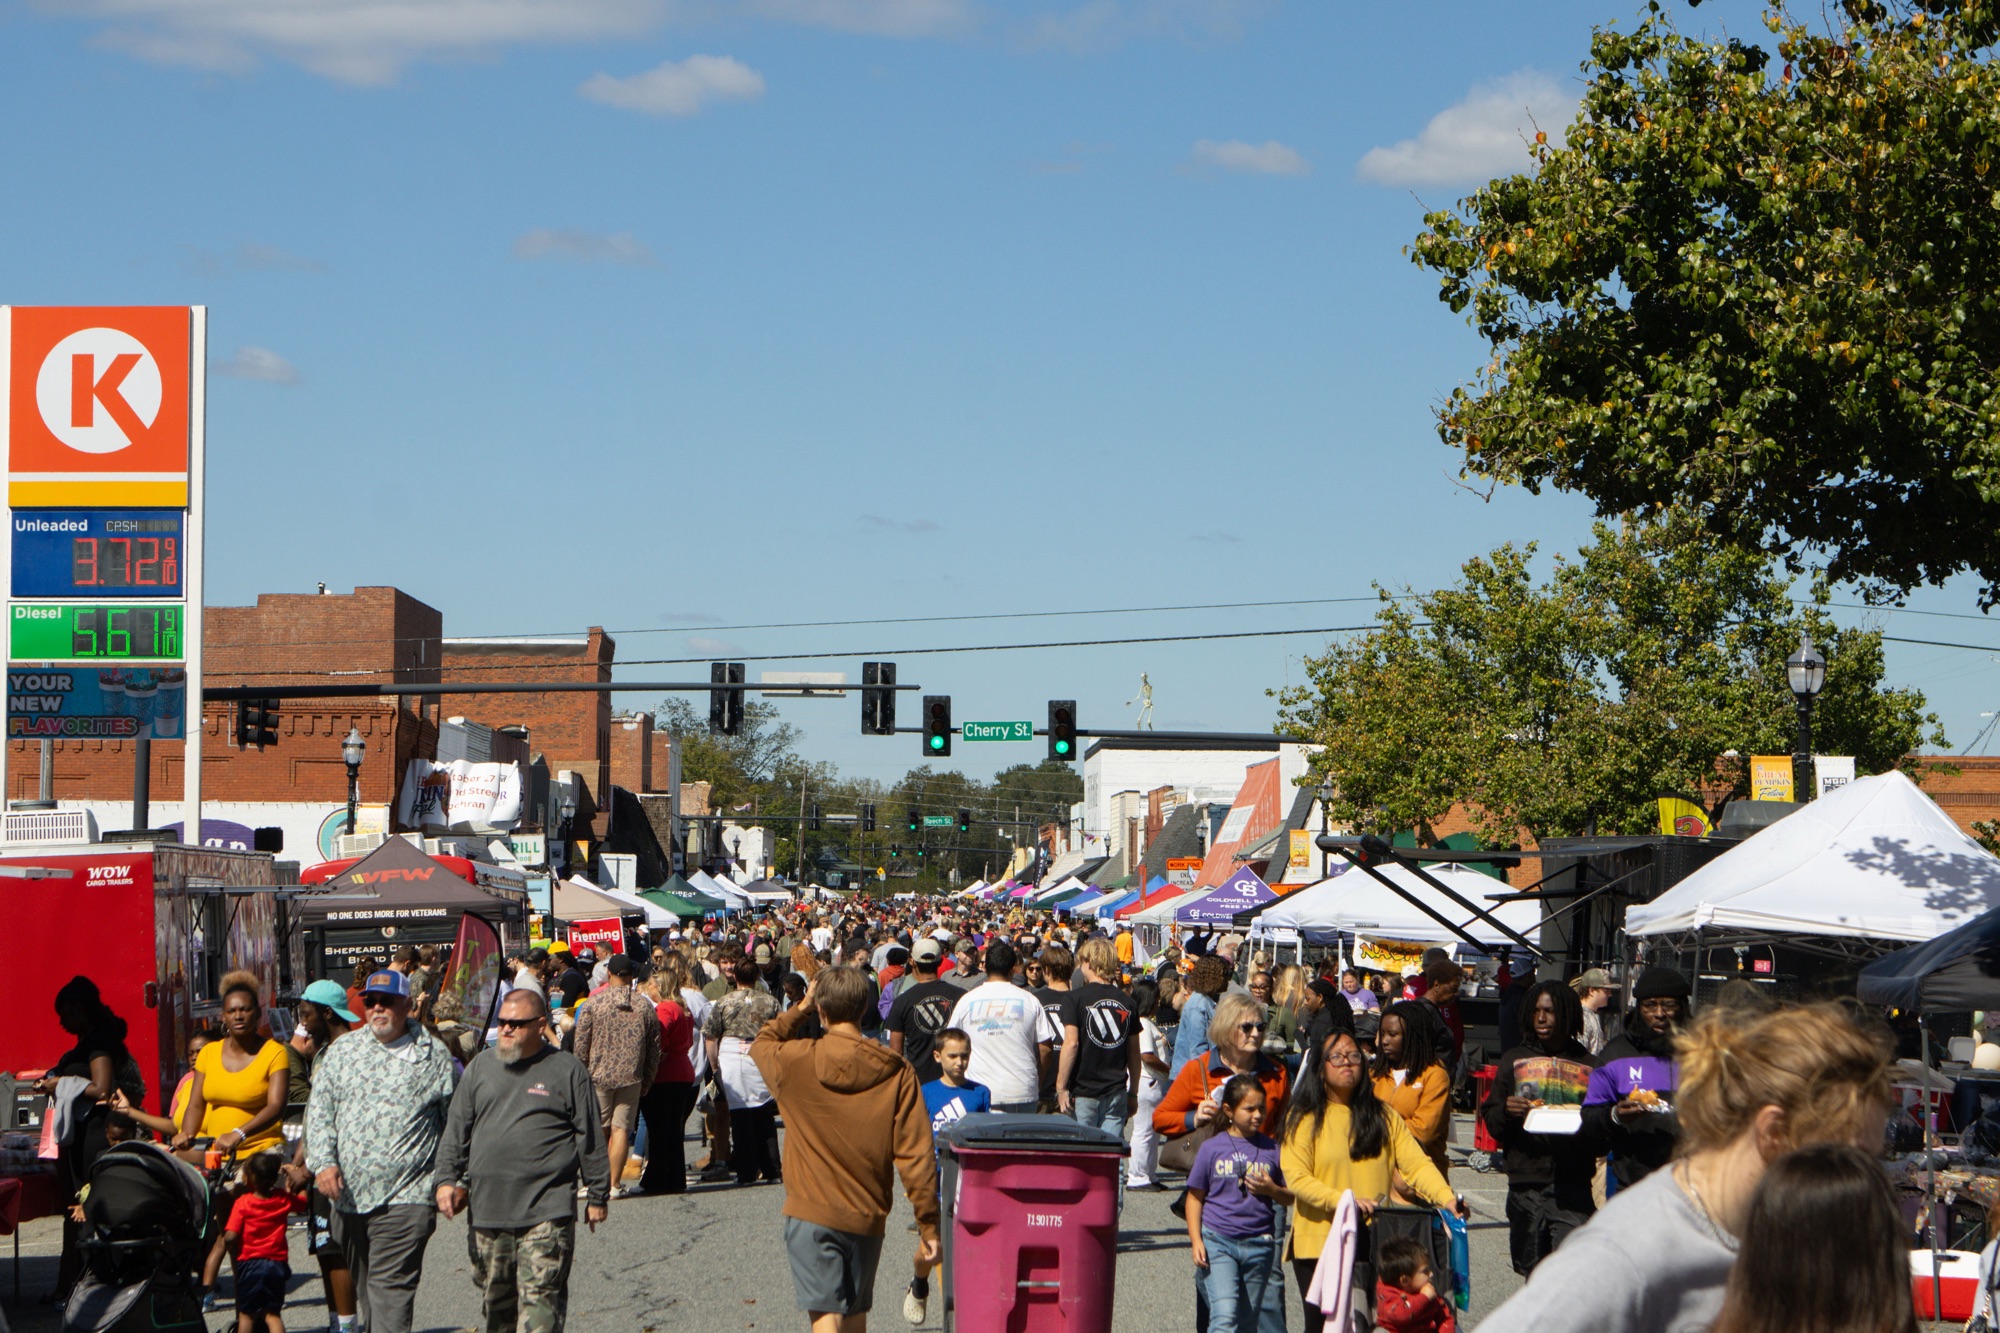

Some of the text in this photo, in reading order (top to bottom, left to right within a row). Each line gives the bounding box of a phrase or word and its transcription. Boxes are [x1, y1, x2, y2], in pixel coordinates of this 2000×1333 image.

[71, 353, 149, 444] K
[15, 519, 139, 532] Unleaded CASH
[74, 537, 160, 585] 3.72
[15, 607, 62, 619] Diesel
[73, 608, 160, 656] 5.61
[10, 675, 72, 691] YOUR
[10, 697, 63, 712] NEW
[9, 717, 138, 735] FLAVORITES
[965, 723, 1031, 739] Cherry St.
[1757, 770, 1788, 778] GREAT
[1759, 787, 1788, 800] Festival
[87, 866, 131, 879] WOW
[362, 867, 436, 884] VFW
[107, 878, 134, 886] TRAILERS
[327, 908, 447, 920] NO ONE DOES MORE FOR VETERANS
[572, 929, 620, 942] Fleming
[1360, 942, 1424, 962] NACH
[971, 999, 1022, 1021] UFC
